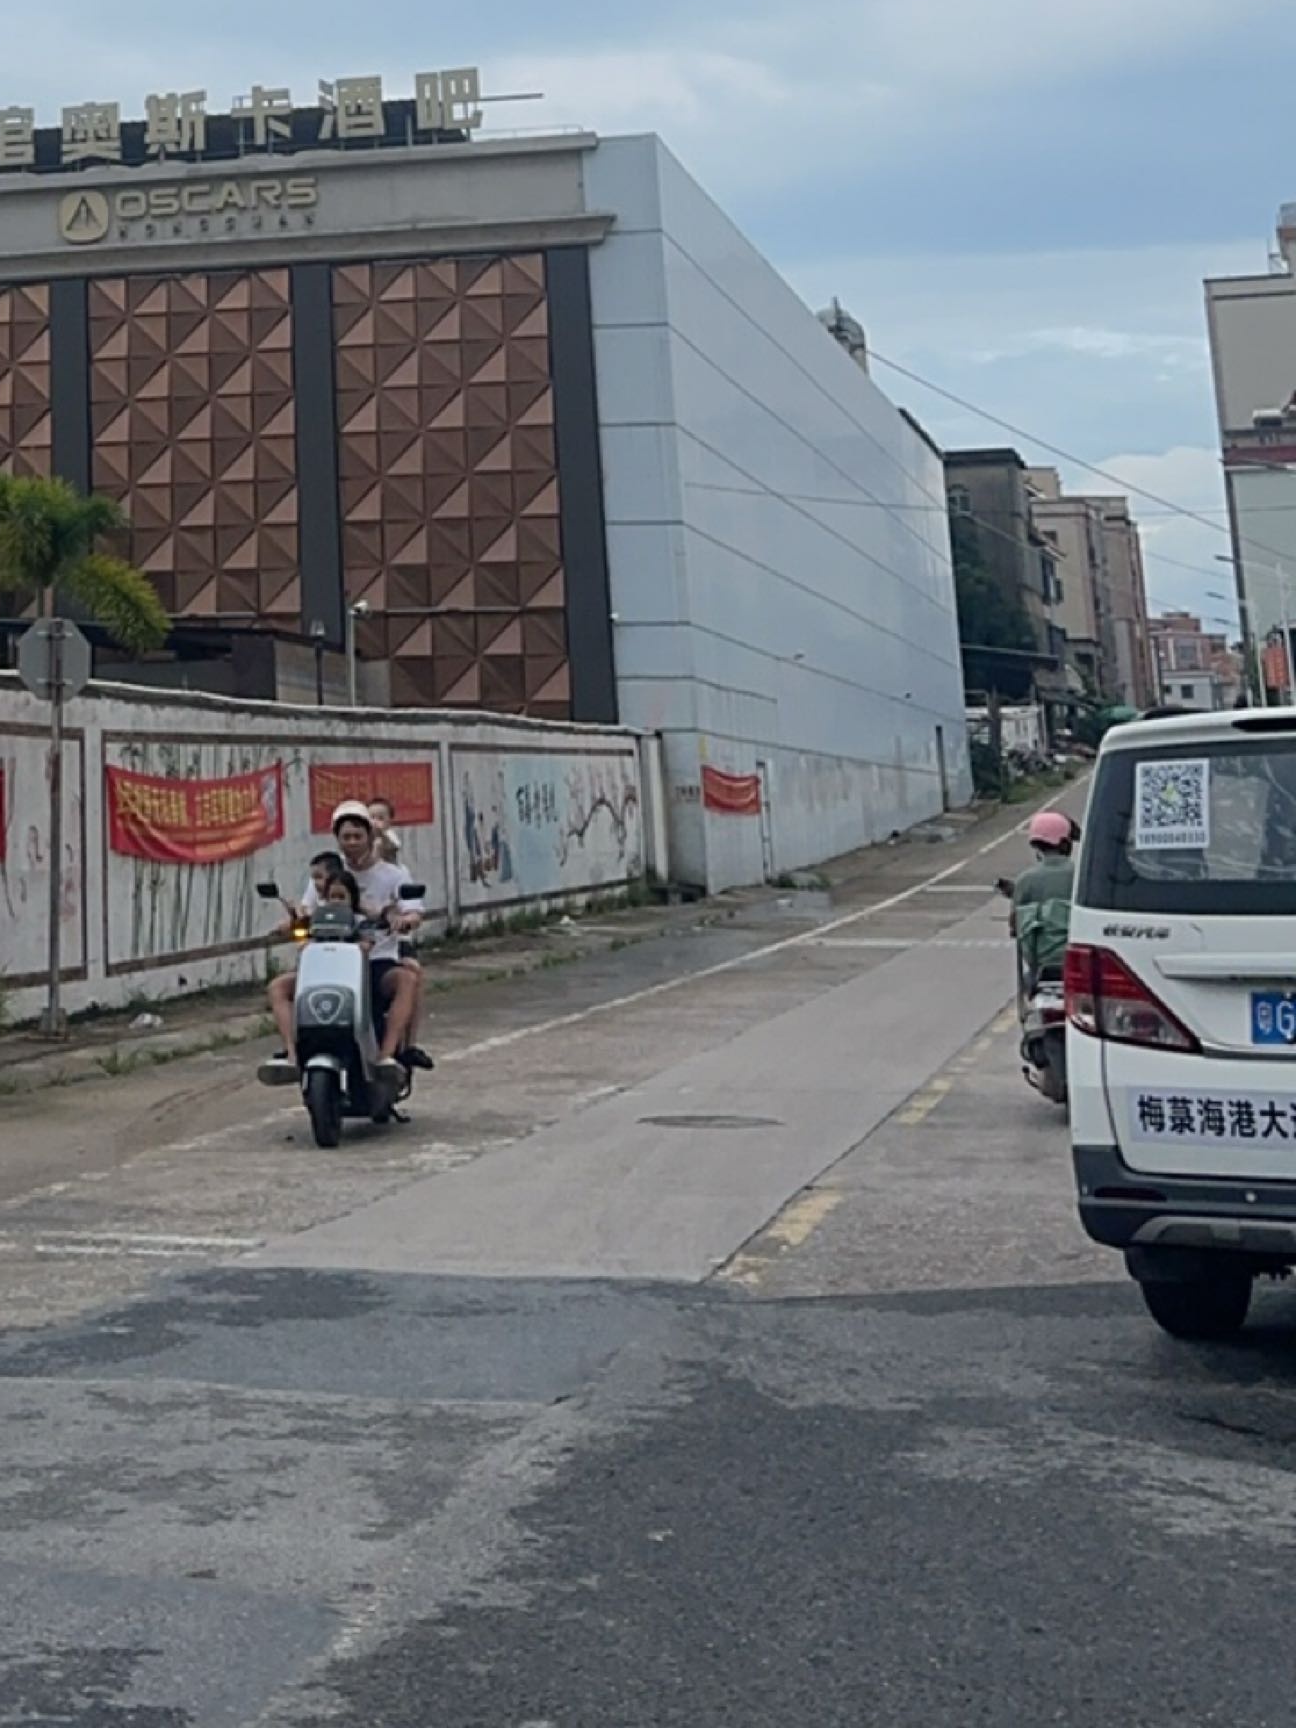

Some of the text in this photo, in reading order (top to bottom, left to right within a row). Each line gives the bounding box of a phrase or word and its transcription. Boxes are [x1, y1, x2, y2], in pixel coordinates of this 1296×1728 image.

[114, 177, 319, 219] OSCARS
[1136, 1093, 1296, 1140] 梅菉海港大
